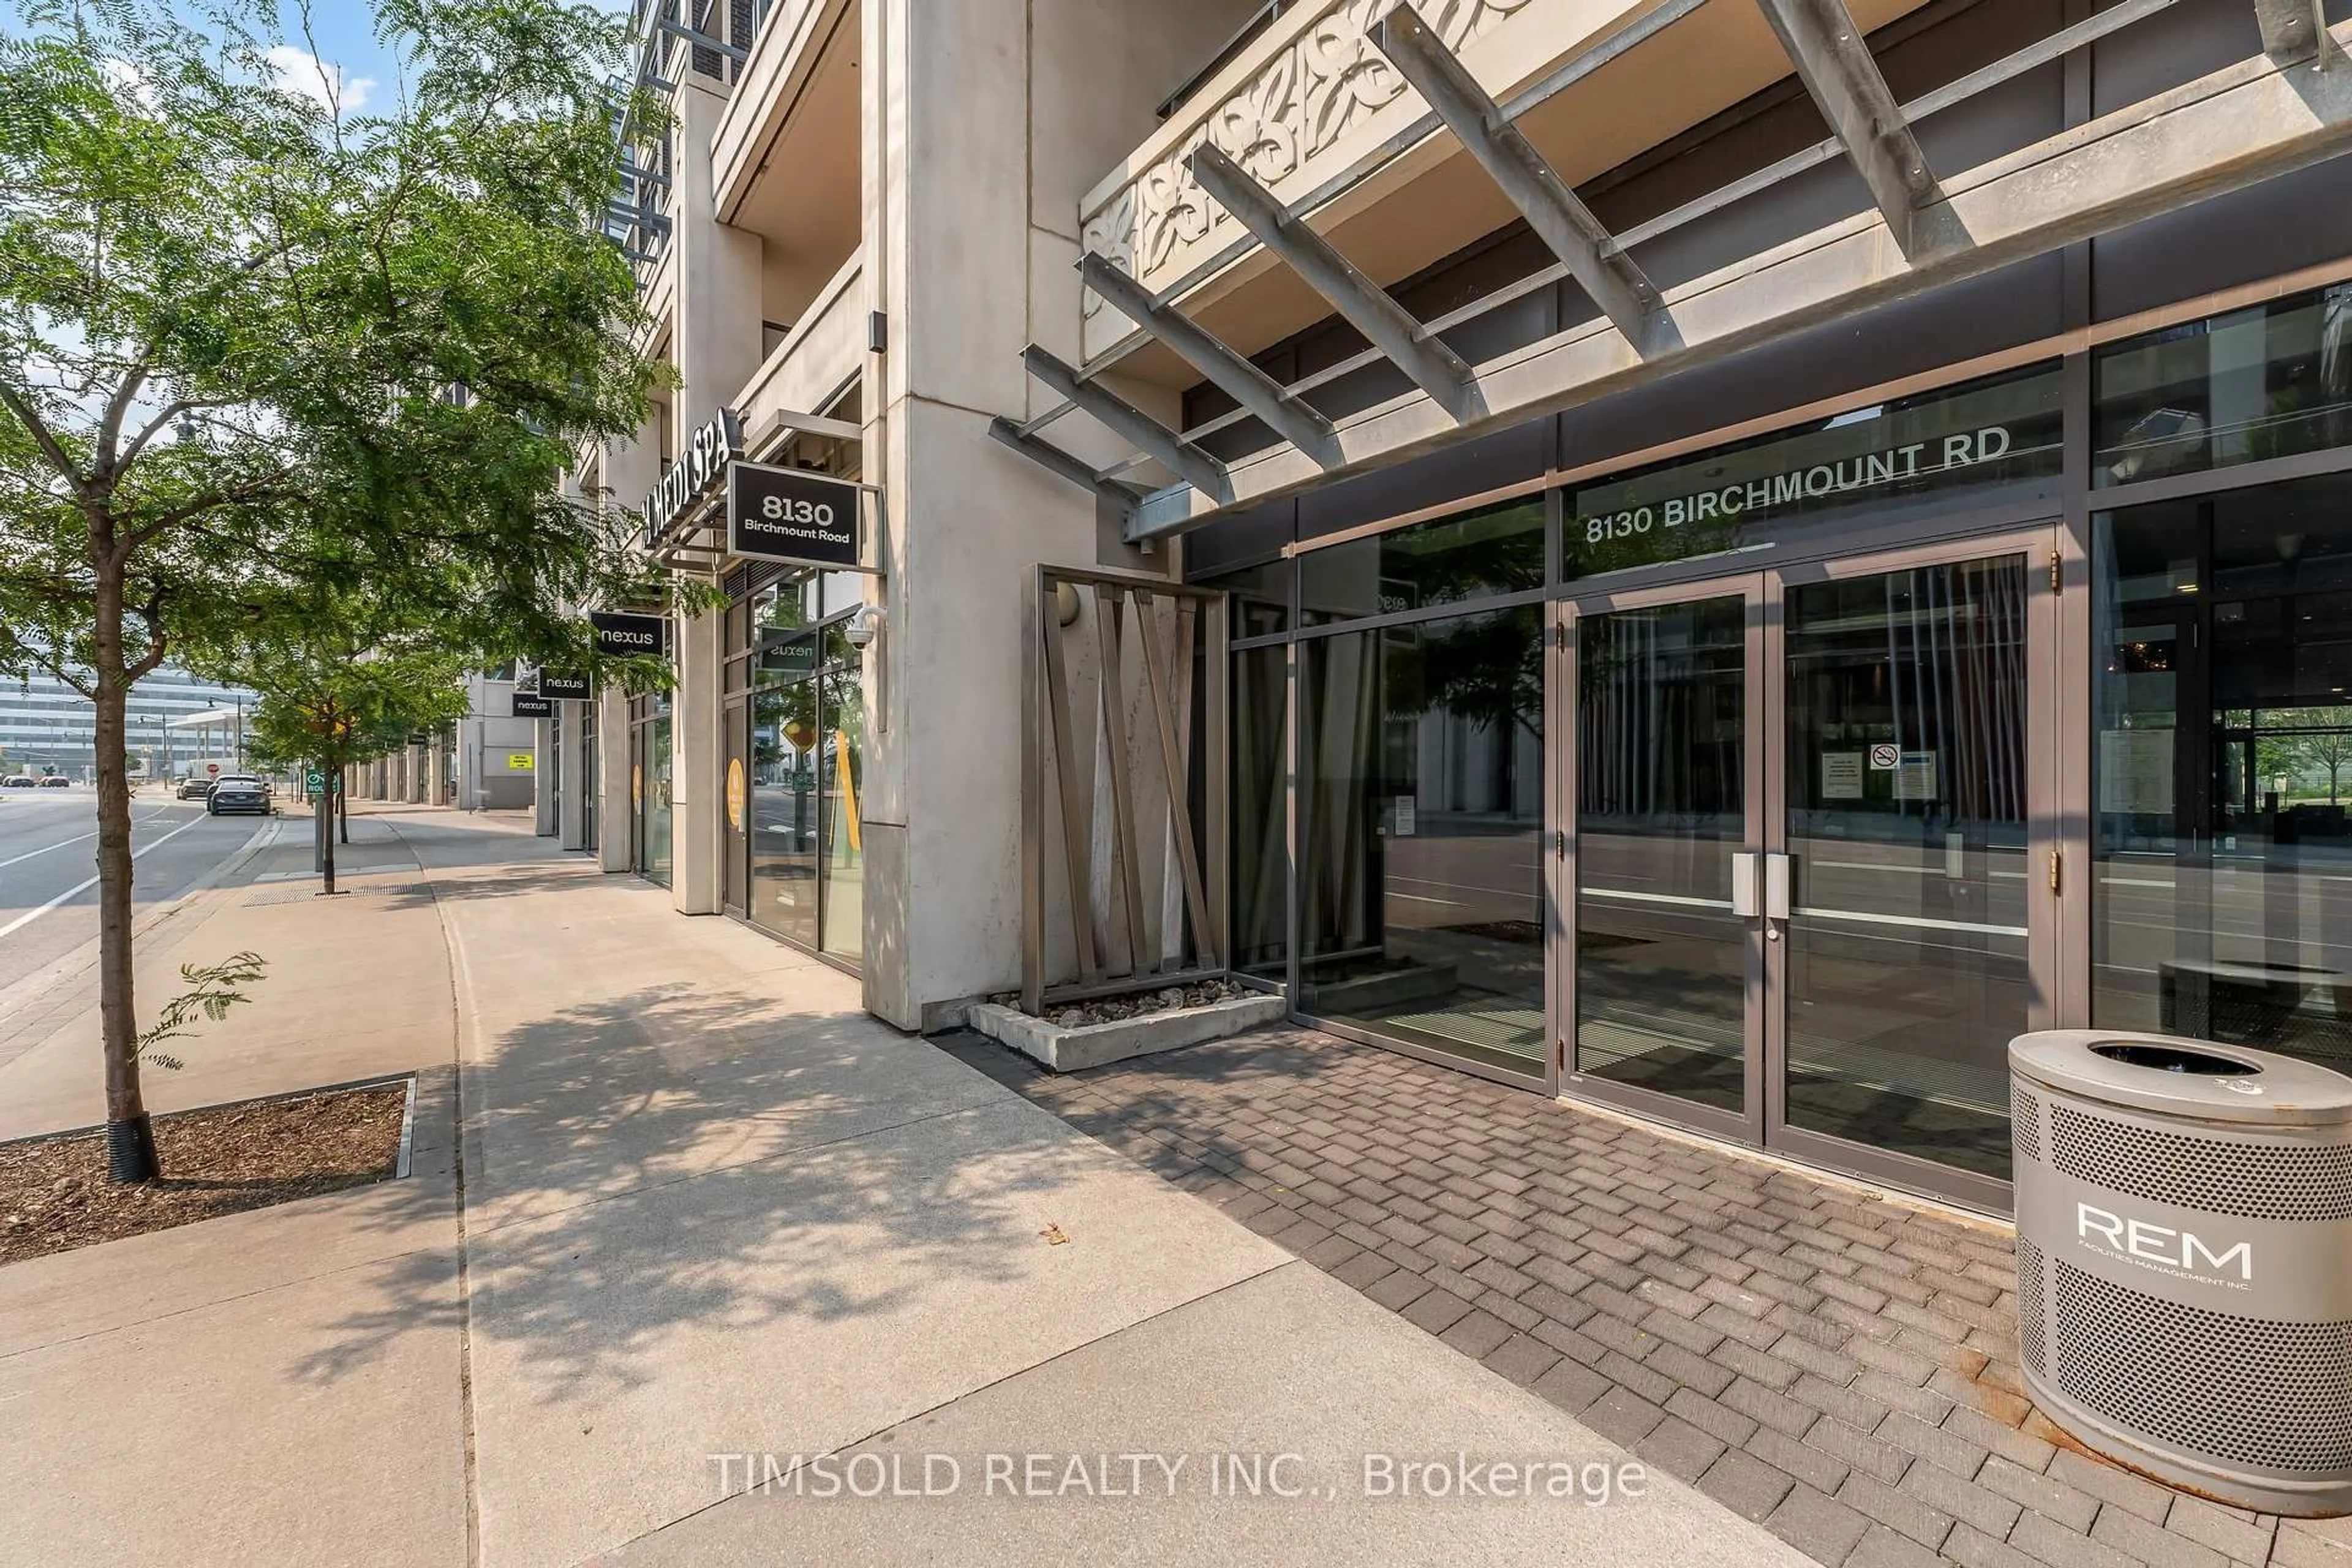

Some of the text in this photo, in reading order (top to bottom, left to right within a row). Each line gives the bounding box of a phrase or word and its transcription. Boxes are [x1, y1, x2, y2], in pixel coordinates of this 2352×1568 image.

[653, 407, 730, 538] MEDI SPA
[1586, 427, 2011, 543] 8130 BIRCHMOUNT RD
[763, 496, 834, 527] 8130
[744, 519, 850, 544] Birchmount Road
[601, 630, 654, 645] nexus
[546, 678, 584, 688] nexus
[518, 702, 548, 710] nexus
[2077, 1202, 2252, 1280] REM
[2078, 1239, 2133, 1265] FACILITIES
[2135, 1260, 2226, 1286] MANAGEMENT
